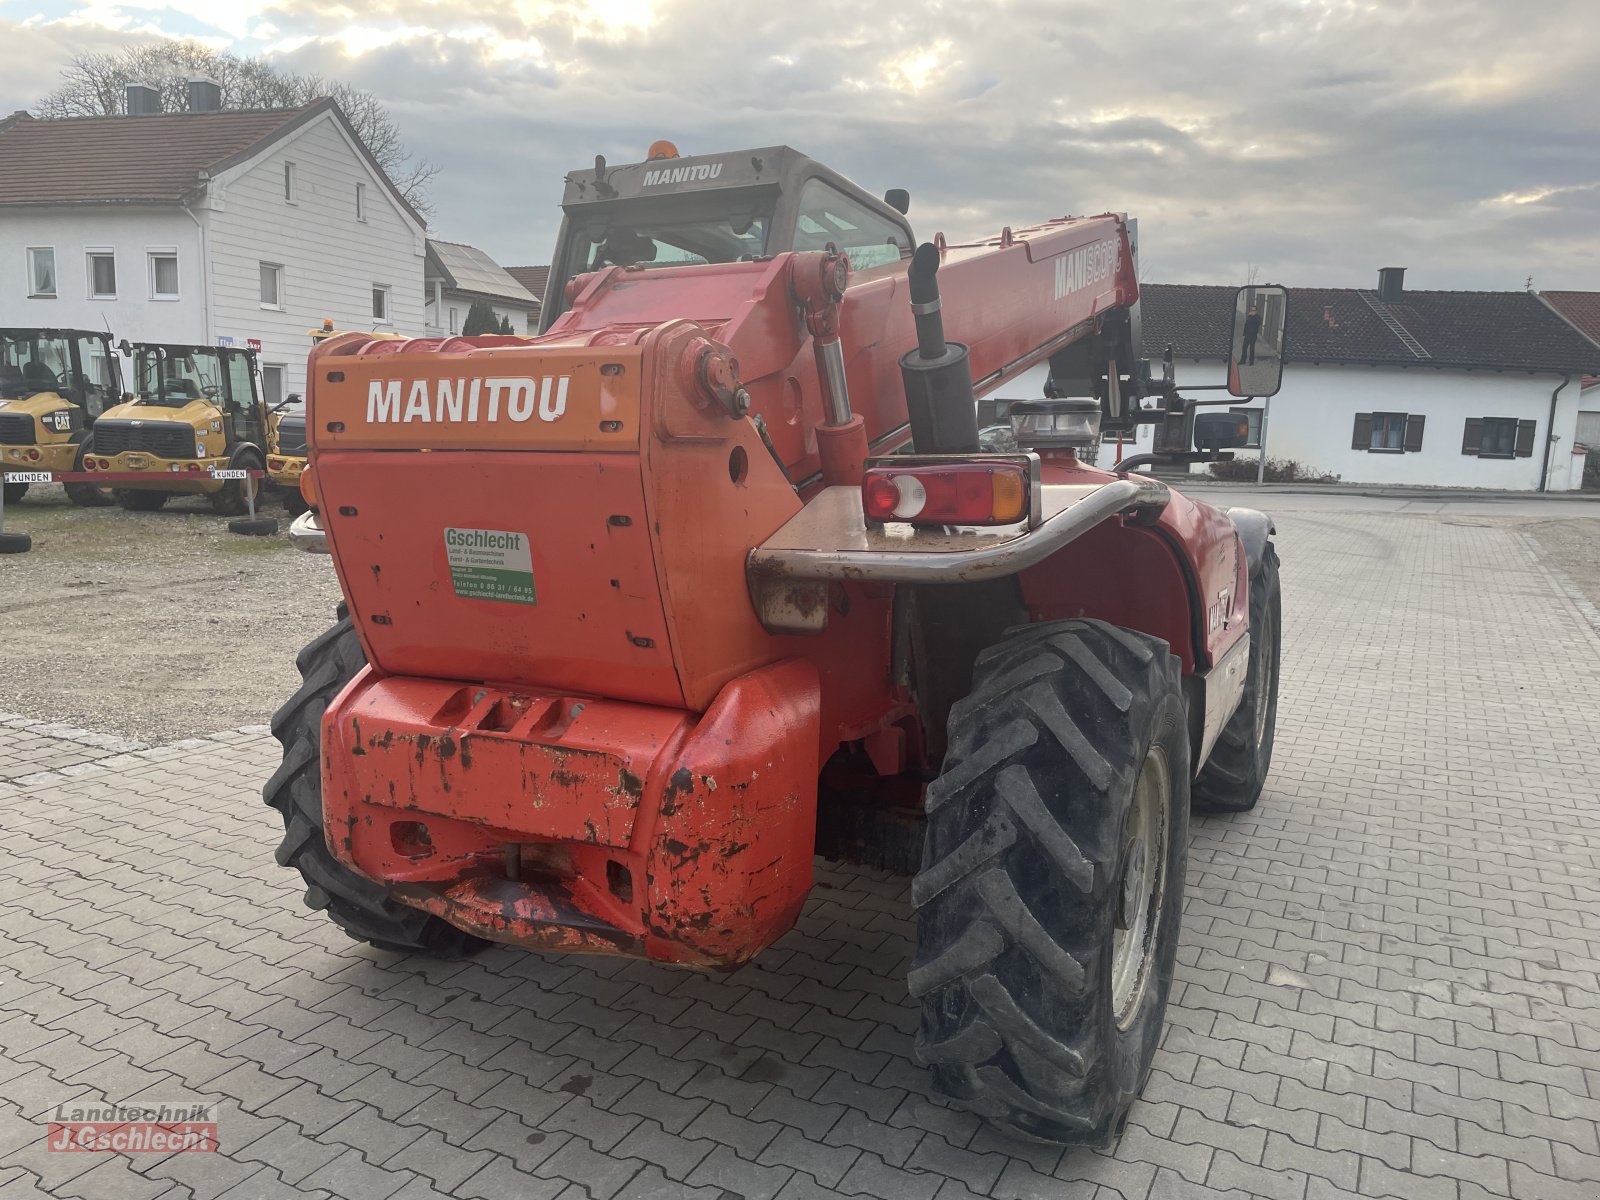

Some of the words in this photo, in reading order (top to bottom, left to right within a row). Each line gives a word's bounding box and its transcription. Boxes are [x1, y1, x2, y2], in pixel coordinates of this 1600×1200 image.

[642, 163, 722, 187] MANITOU
[366, 376, 570, 423] MANITOU
[54, 416, 70, 430] CAT
[211, 420, 221, 432] CAT
[11, 473, 49, 482] KUNDEN
[447, 529, 520, 550] Gschlecht
[454, 580, 478, 589] Telefon
